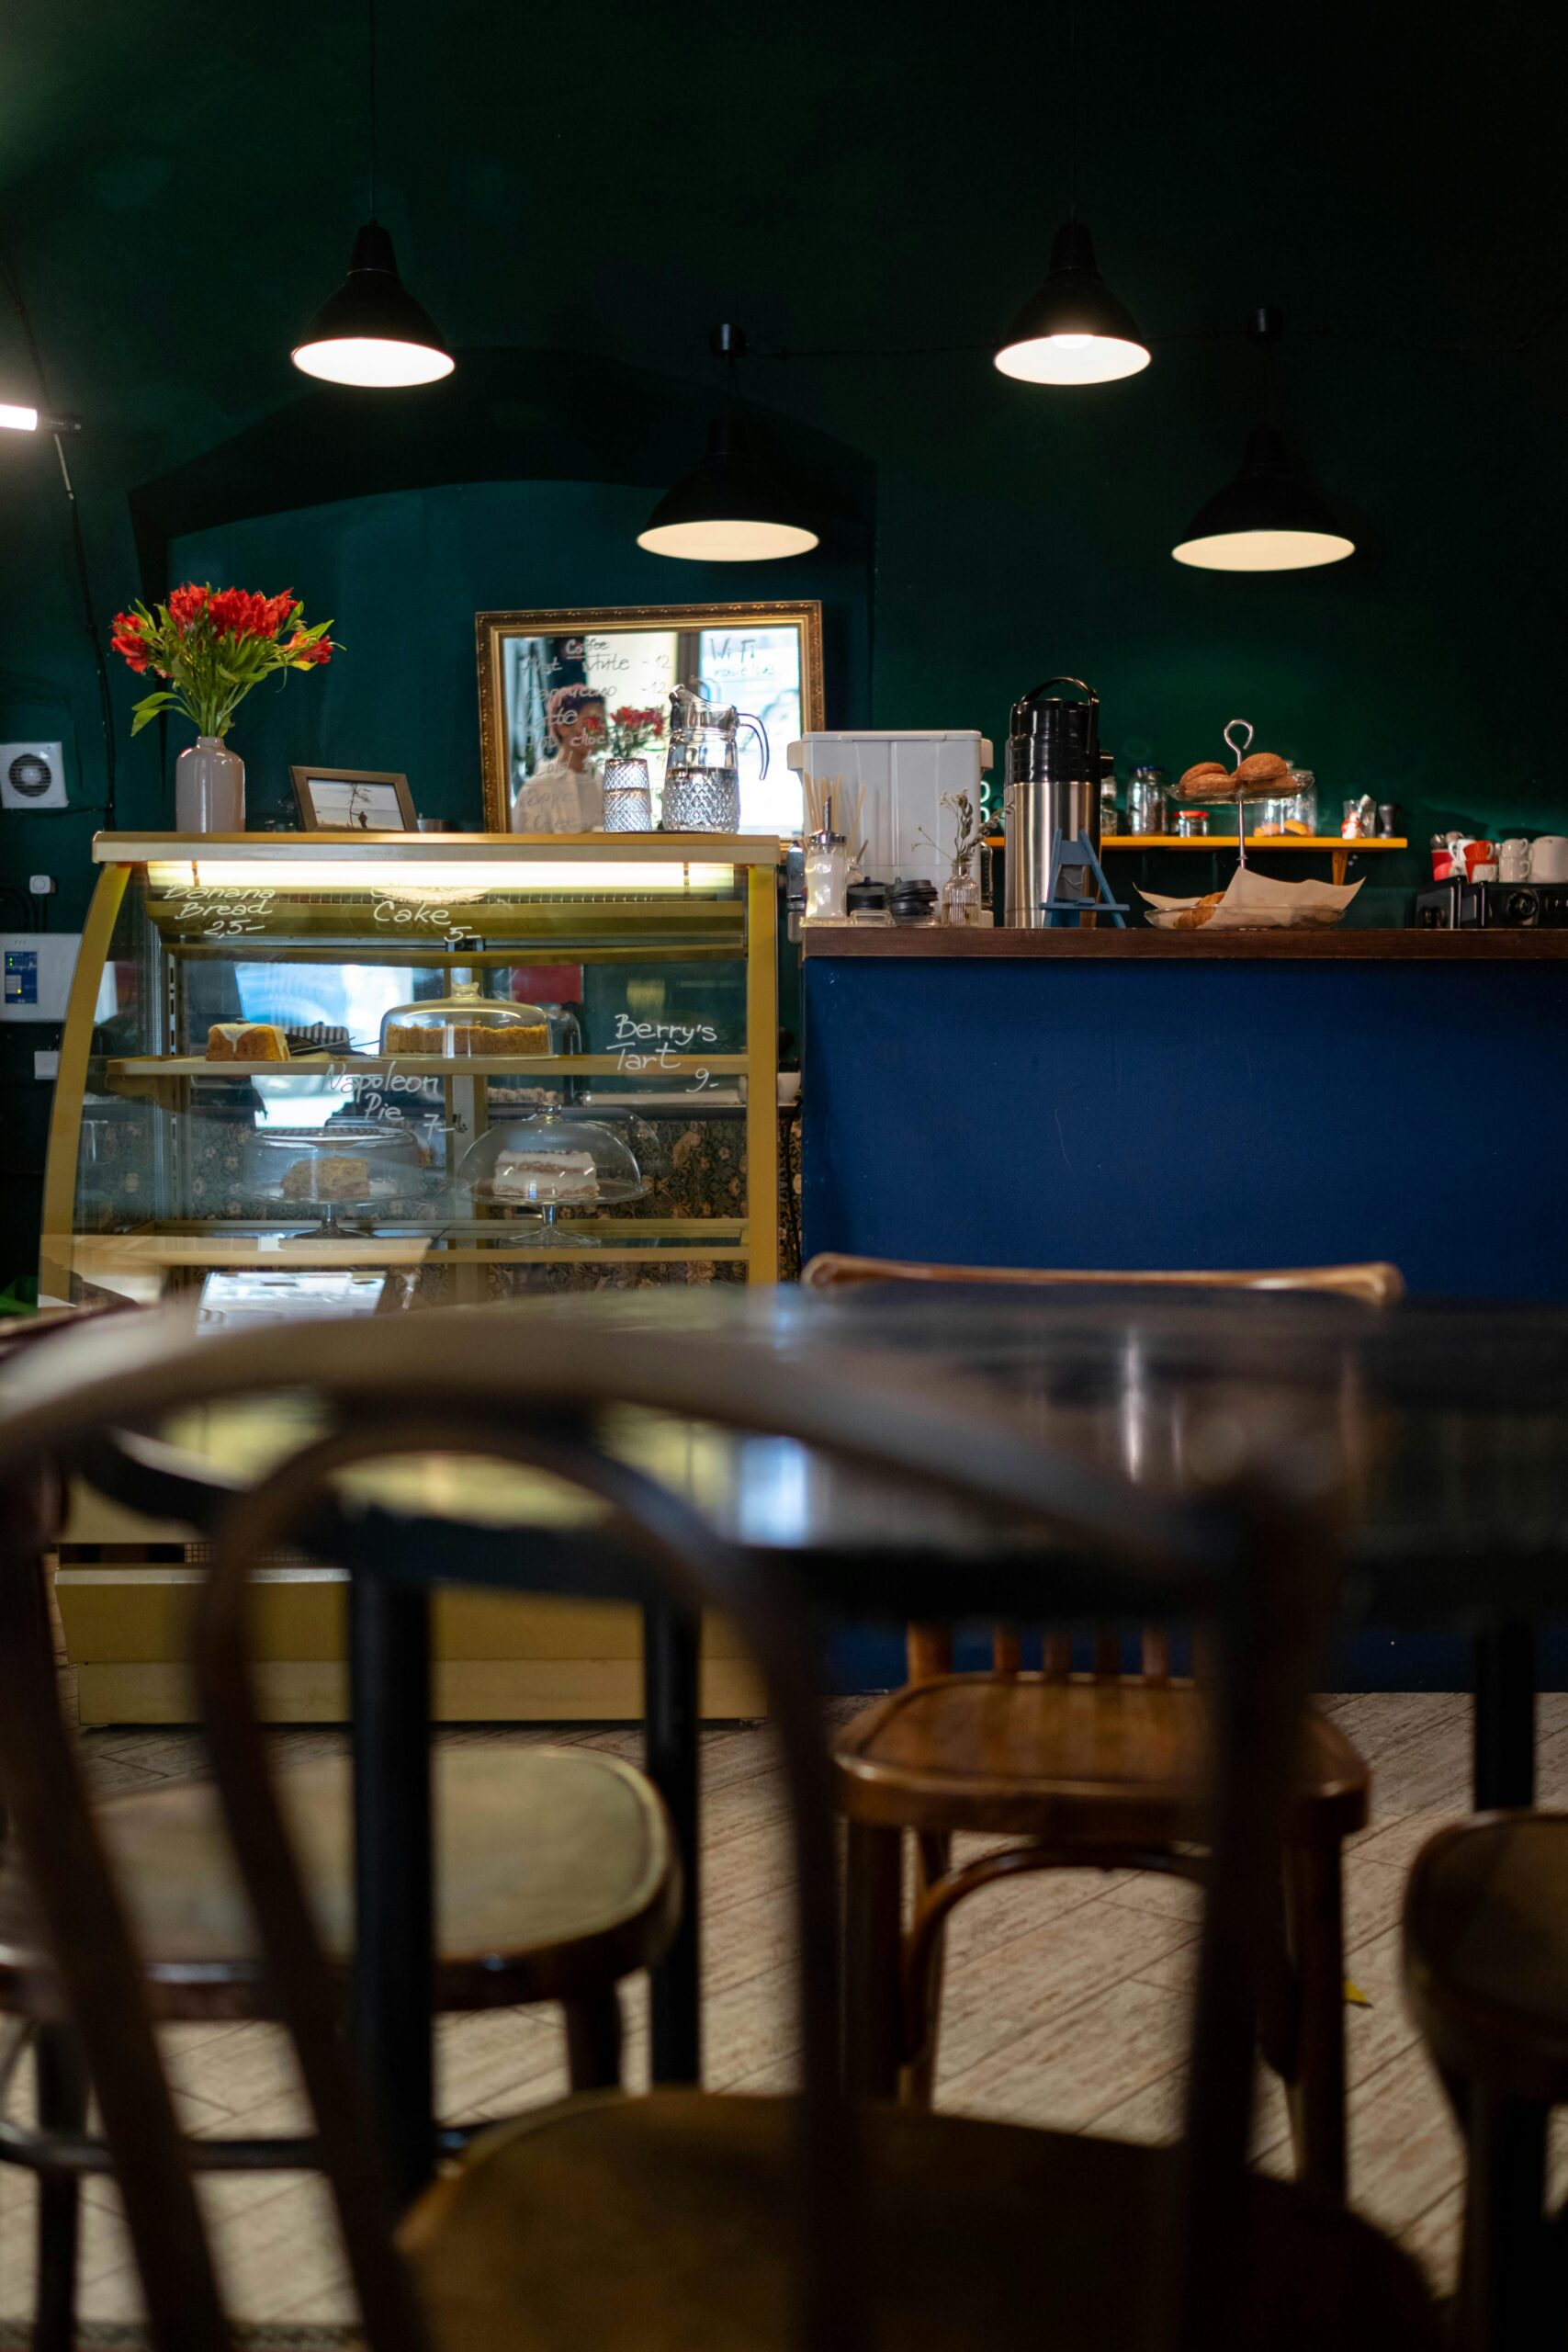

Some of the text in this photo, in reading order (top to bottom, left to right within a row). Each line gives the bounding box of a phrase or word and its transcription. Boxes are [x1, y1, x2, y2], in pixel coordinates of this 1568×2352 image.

[163, 882, 276, 900] Banana
[175, 899, 274, 920] Bread
[373, 900, 452, 925] Cake
[615, 1013, 717, 1046] Berry's
[606, 1041, 682, 1071] Tart
[321, 1060, 439, 1103] Napoleon
[365, 1091, 405, 1121] Pie
